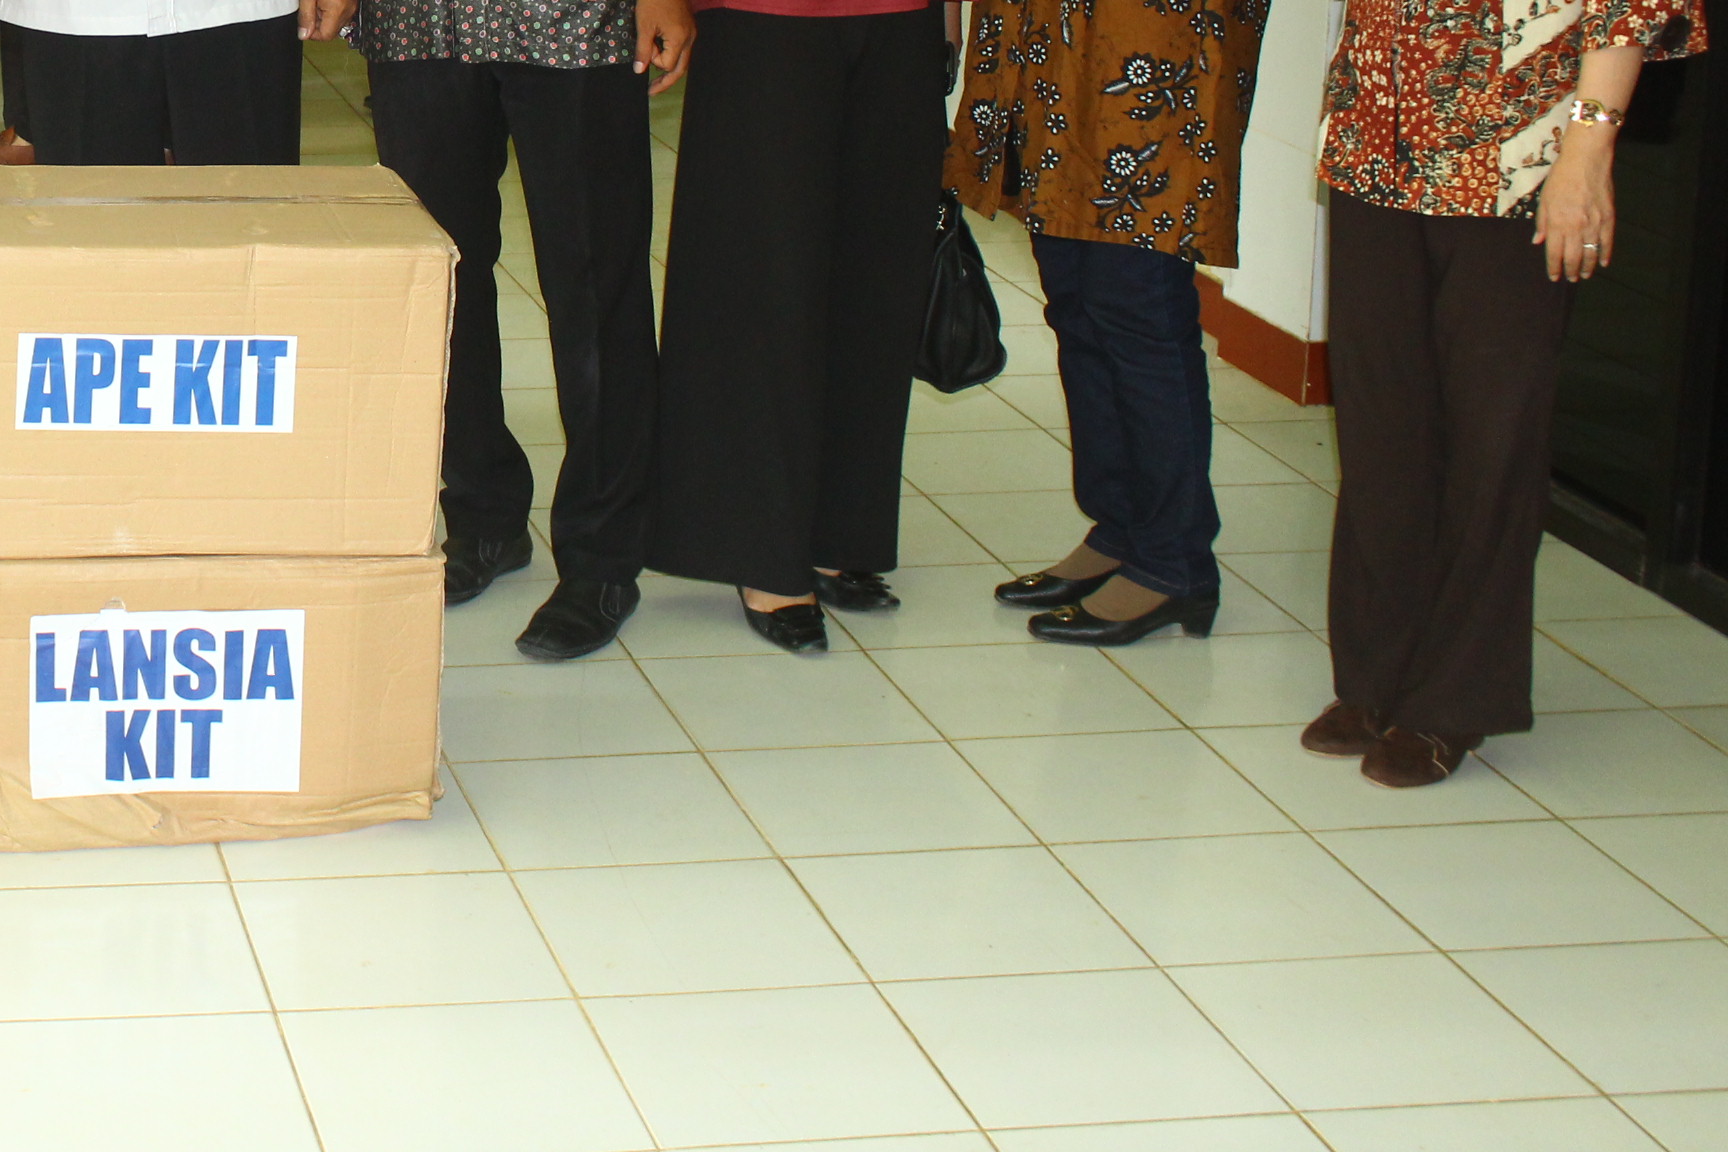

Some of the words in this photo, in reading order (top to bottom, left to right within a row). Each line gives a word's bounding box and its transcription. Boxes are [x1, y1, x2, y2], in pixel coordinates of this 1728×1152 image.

[24, 338, 153, 424] APE
[174, 340, 288, 426] KIT
[35, 628, 295, 702] LANSIA
[106, 711, 223, 782] KIT
